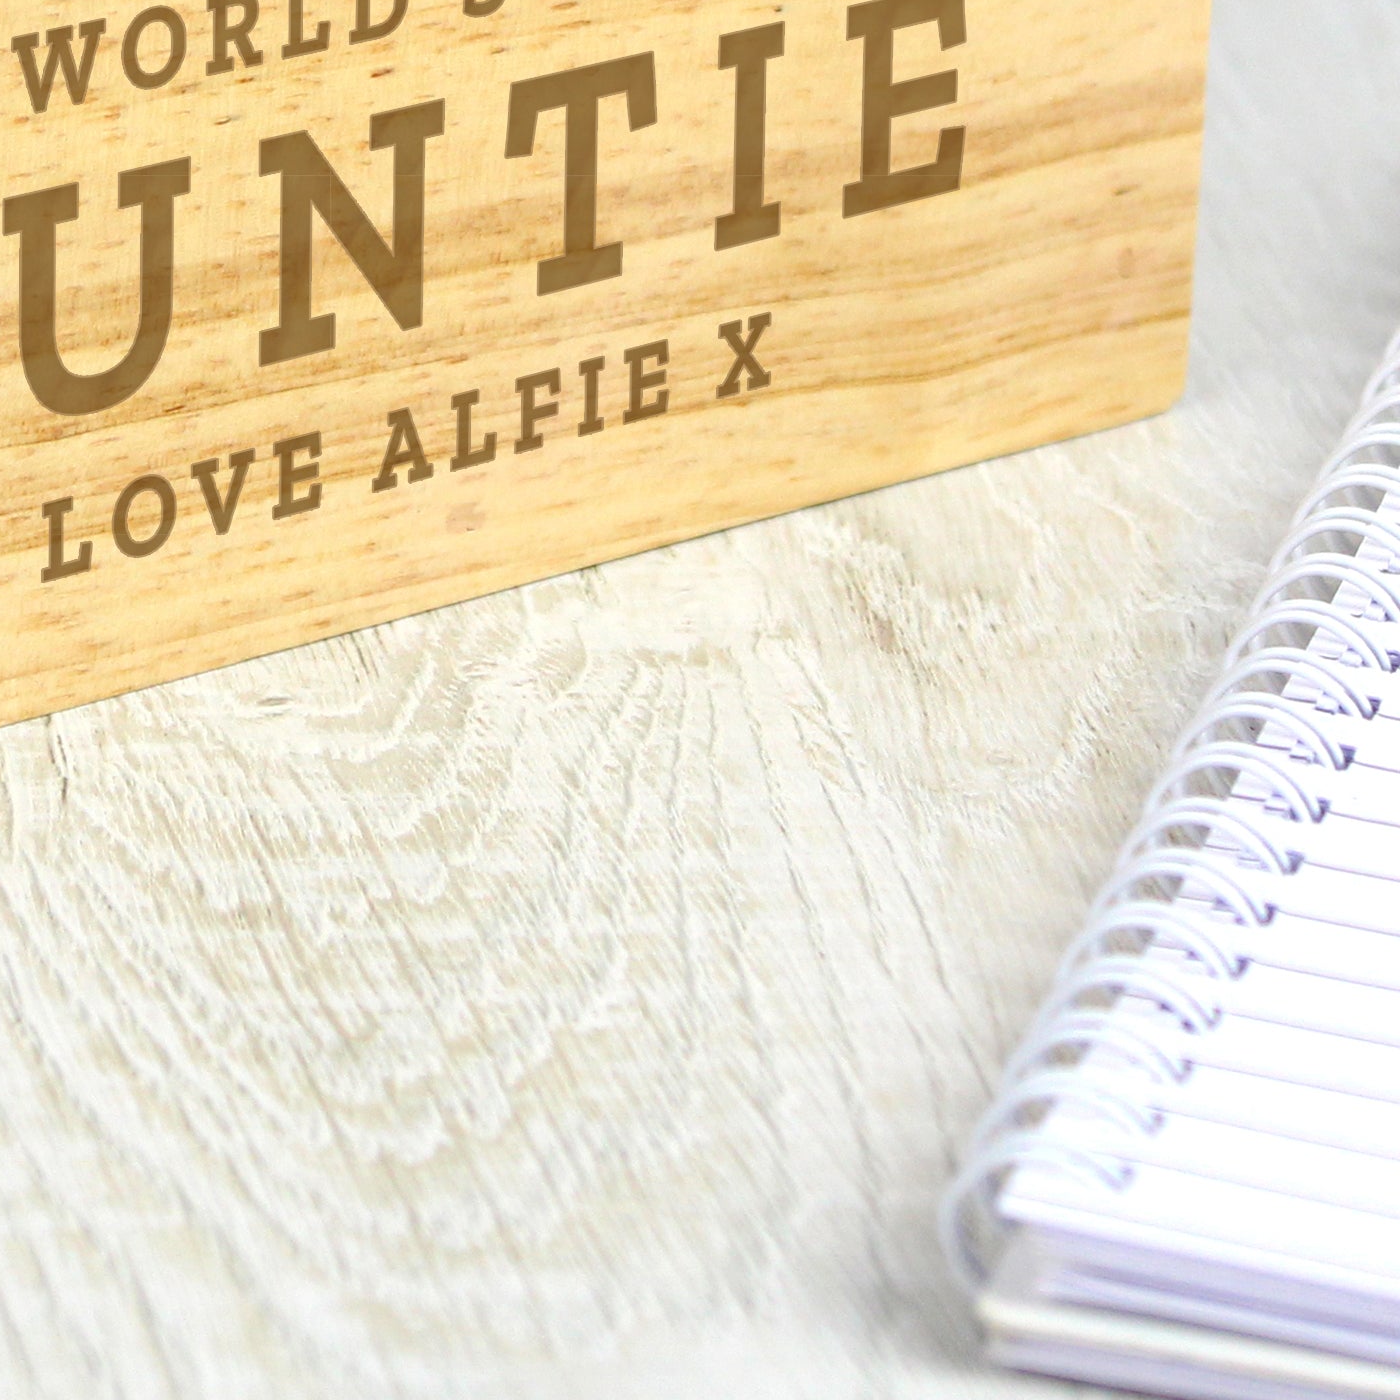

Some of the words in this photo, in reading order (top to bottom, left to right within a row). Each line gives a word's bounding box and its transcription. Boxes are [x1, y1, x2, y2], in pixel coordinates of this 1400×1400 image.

[41, 430, 323, 583] LOVE
[371, 339, 670, 494] ALFIE
[715, 311, 773, 400] X
